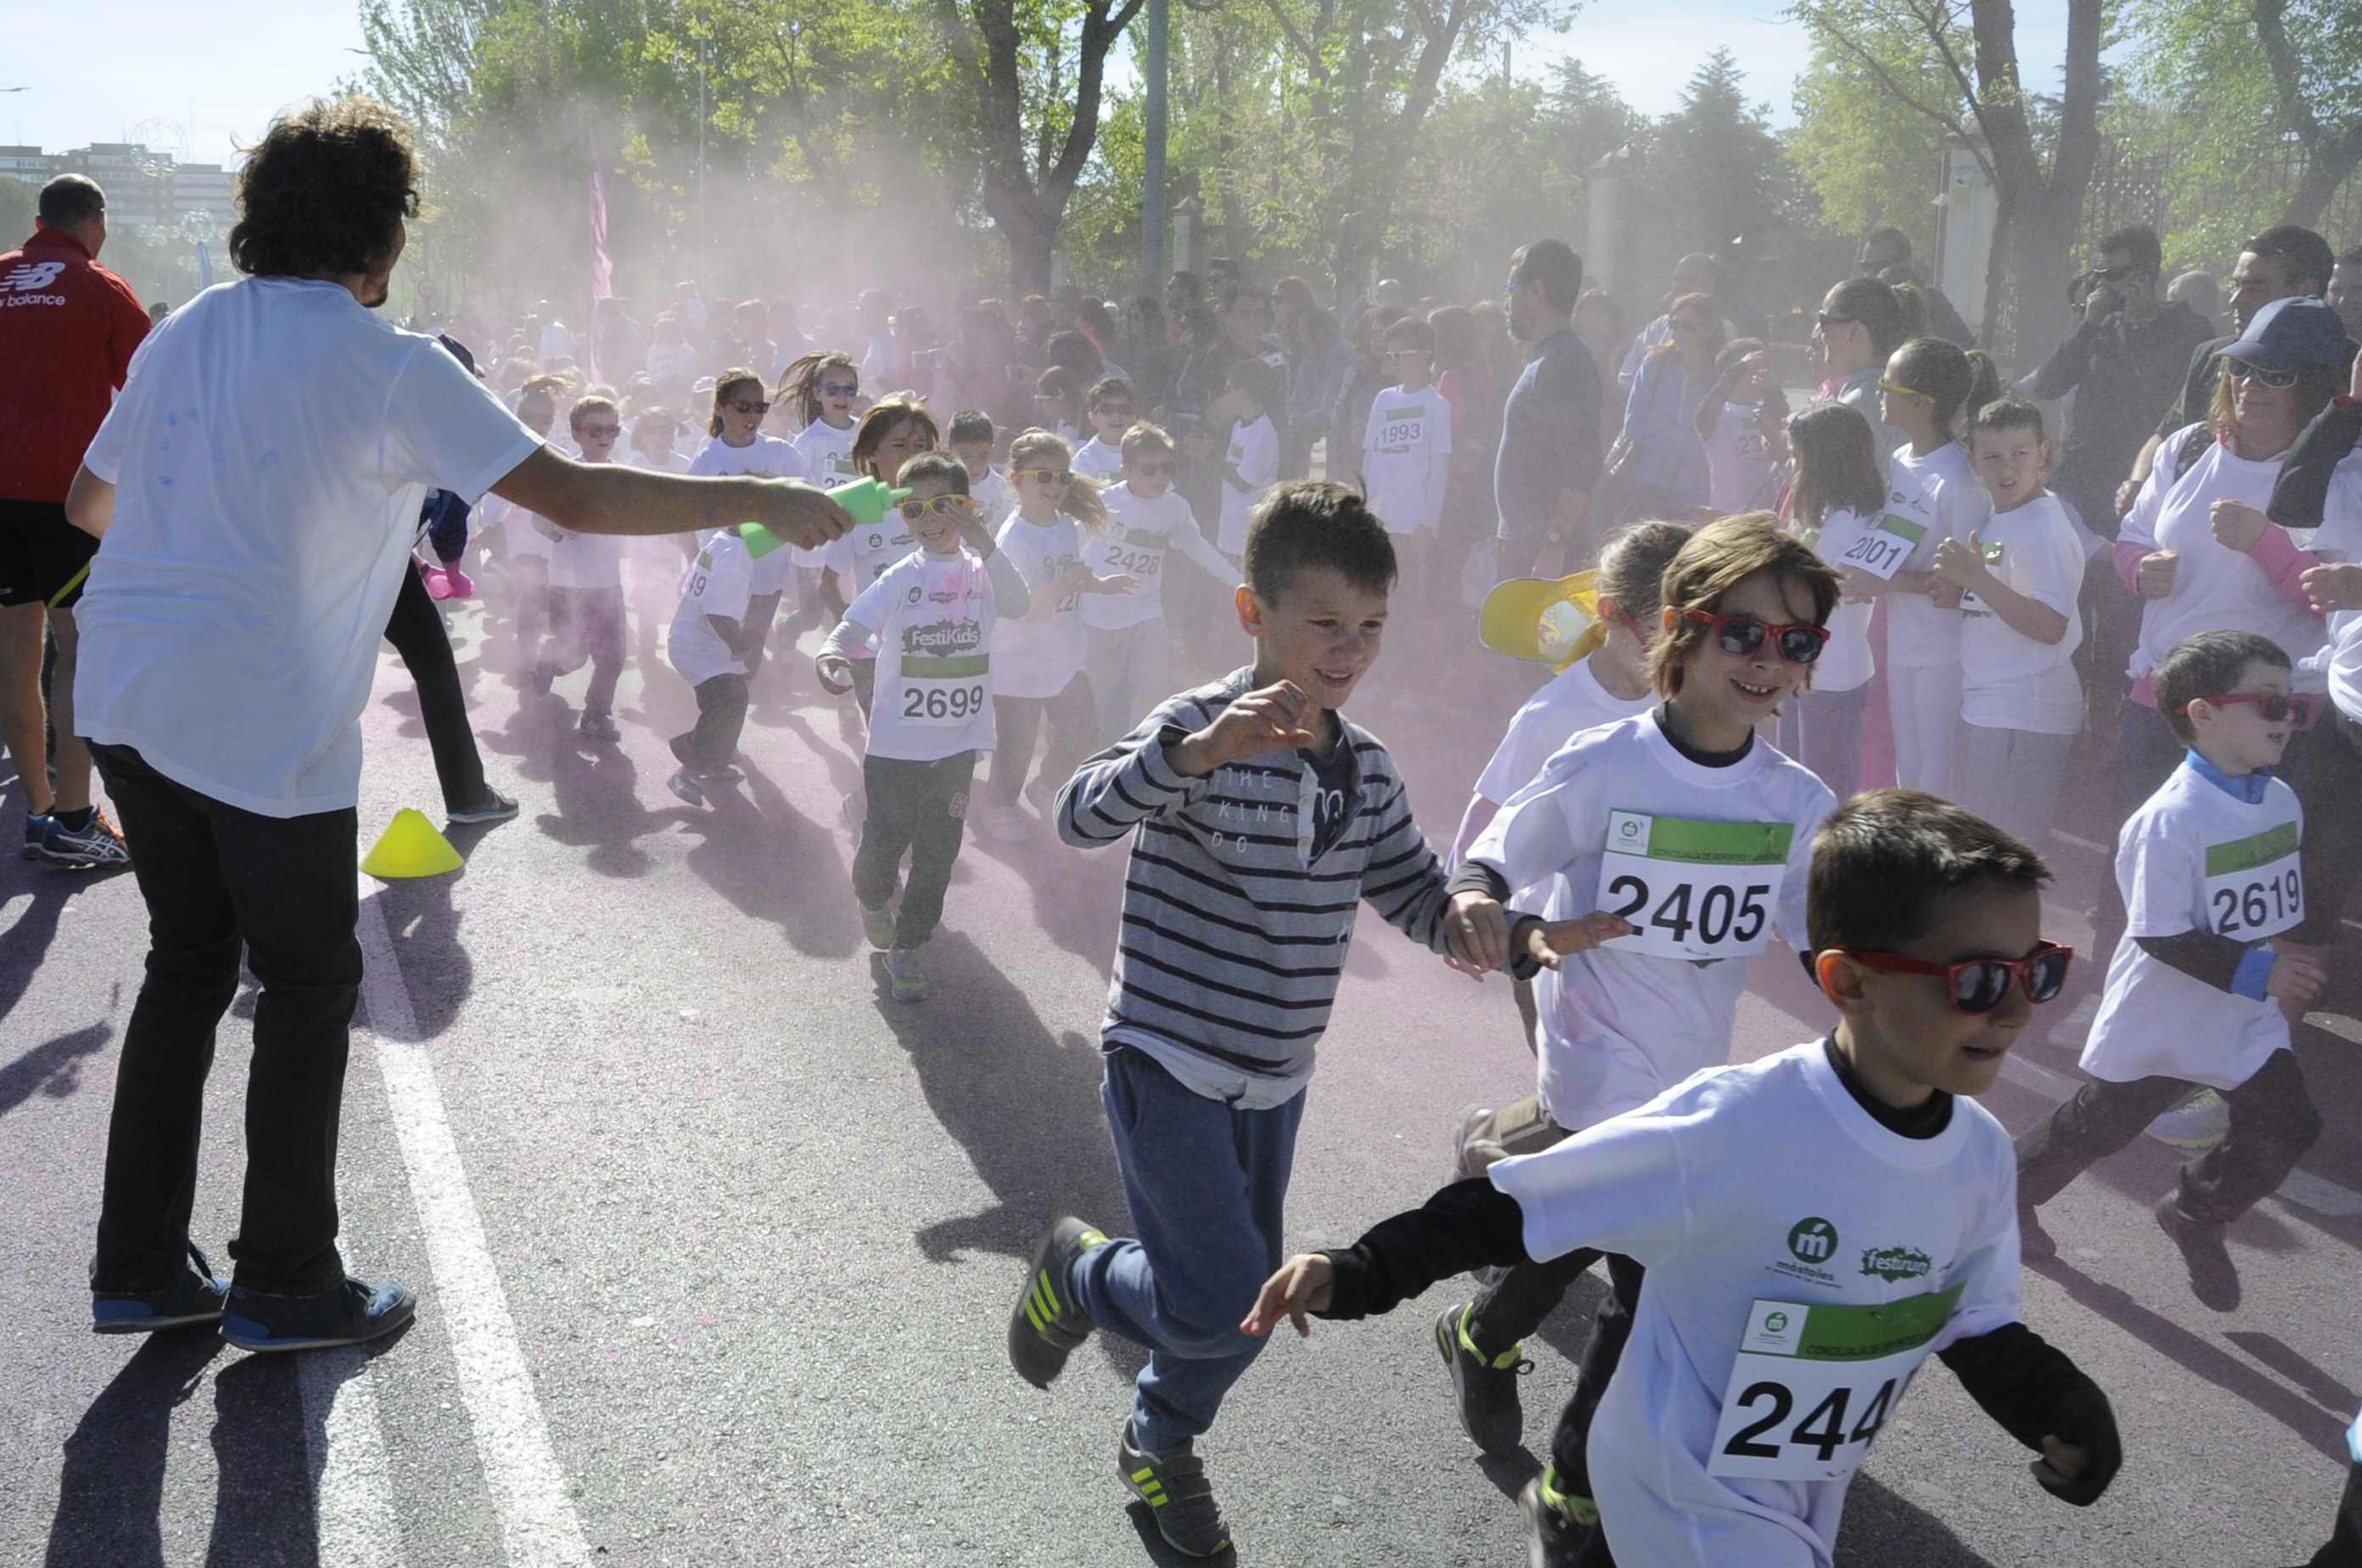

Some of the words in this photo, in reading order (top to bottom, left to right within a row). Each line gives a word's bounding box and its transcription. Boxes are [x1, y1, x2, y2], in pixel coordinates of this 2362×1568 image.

[7, 294, 65, 307] balance
[1381, 423, 1420, 444] 1993
[1105, 546, 1161, 575] 2428
[912, 628, 979, 646] FestiKids
[903, 684, 984, 720] 2699
[1226, 767, 1273, 789] THE
[1218, 799, 1290, 824] KING
[1211, 831, 1248, 854] DO
[1609, 875, 1771, 945] 2405
[2213, 868, 2300, 934] 2619
[1867, 1250, 1929, 1274] festirun
